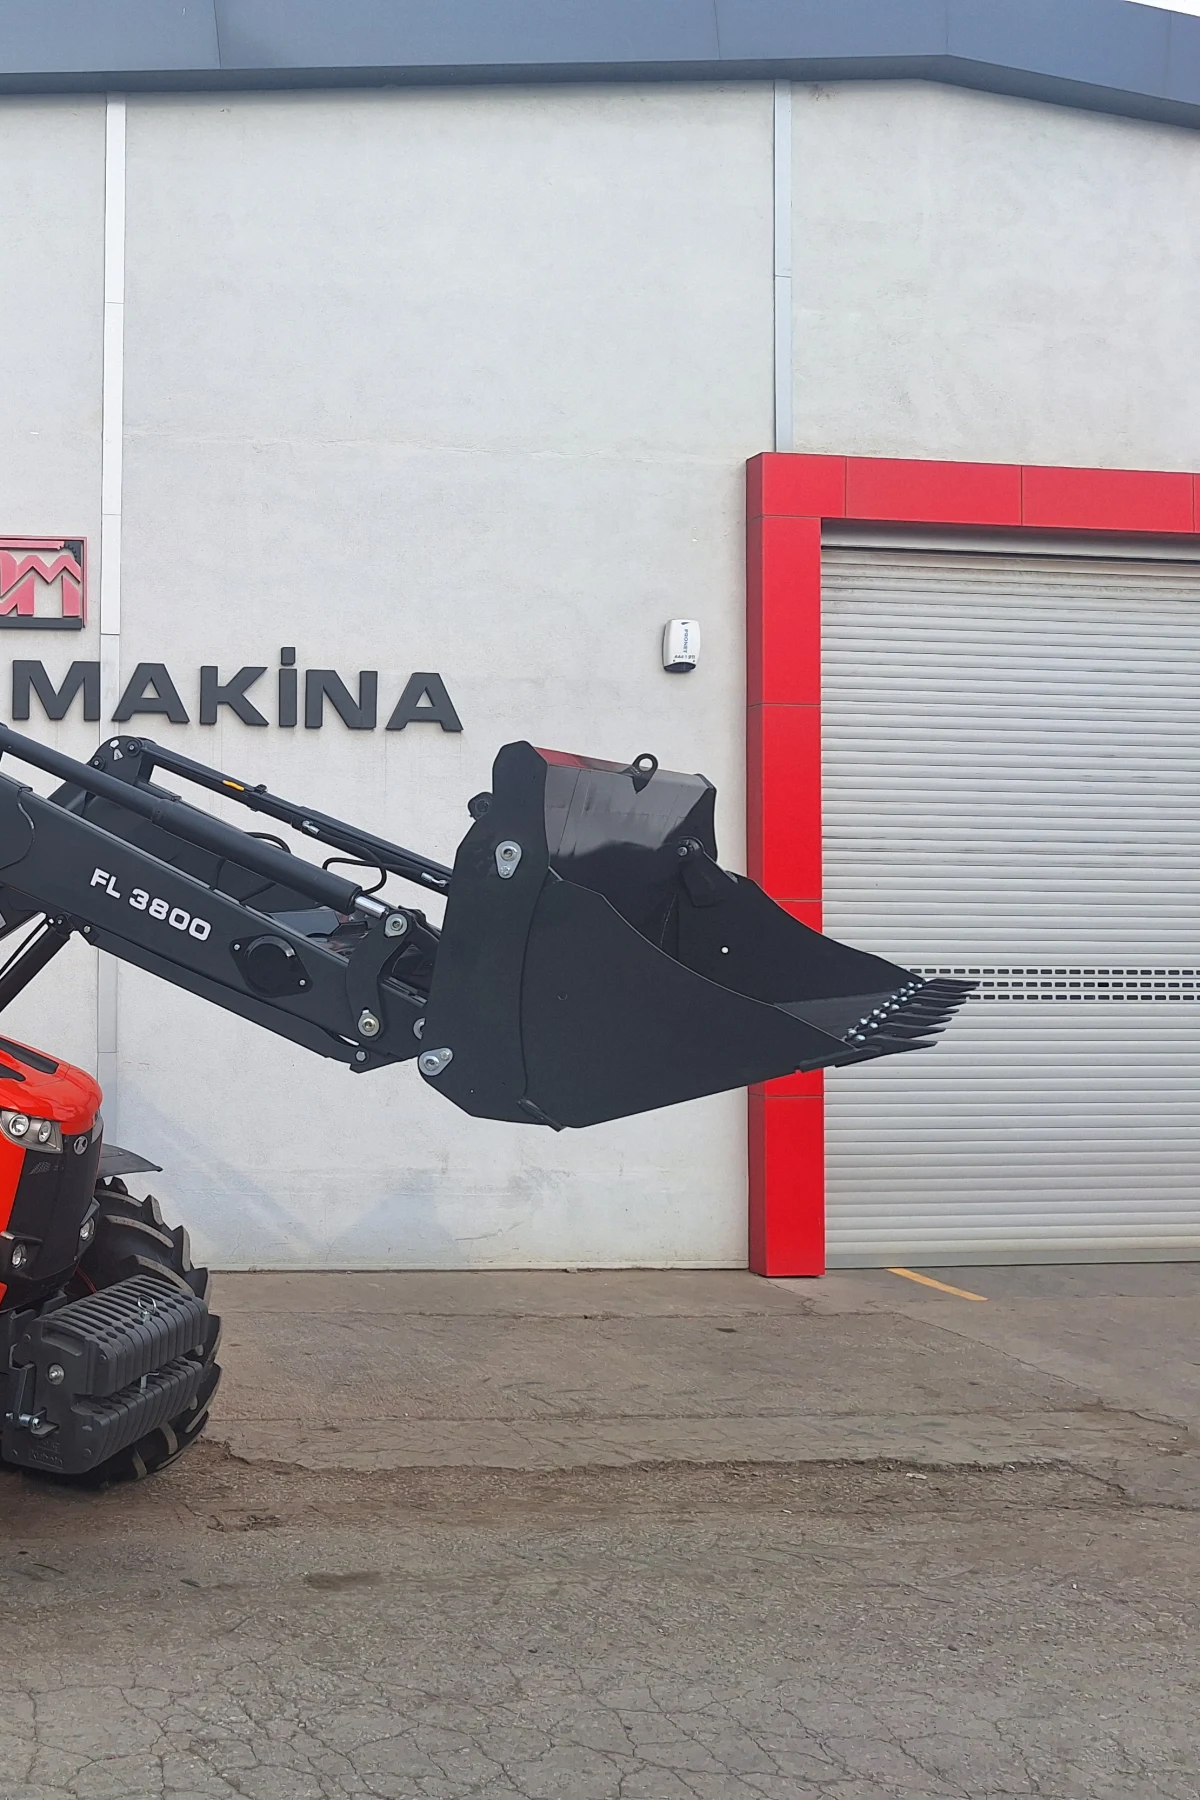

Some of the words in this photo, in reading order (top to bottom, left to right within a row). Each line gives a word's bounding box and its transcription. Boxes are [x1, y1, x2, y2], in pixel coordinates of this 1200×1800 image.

[12, 647, 464, 732] MAKİNA
[90, 867, 121, 899] FL
[128, 888, 212, 941] 3800
